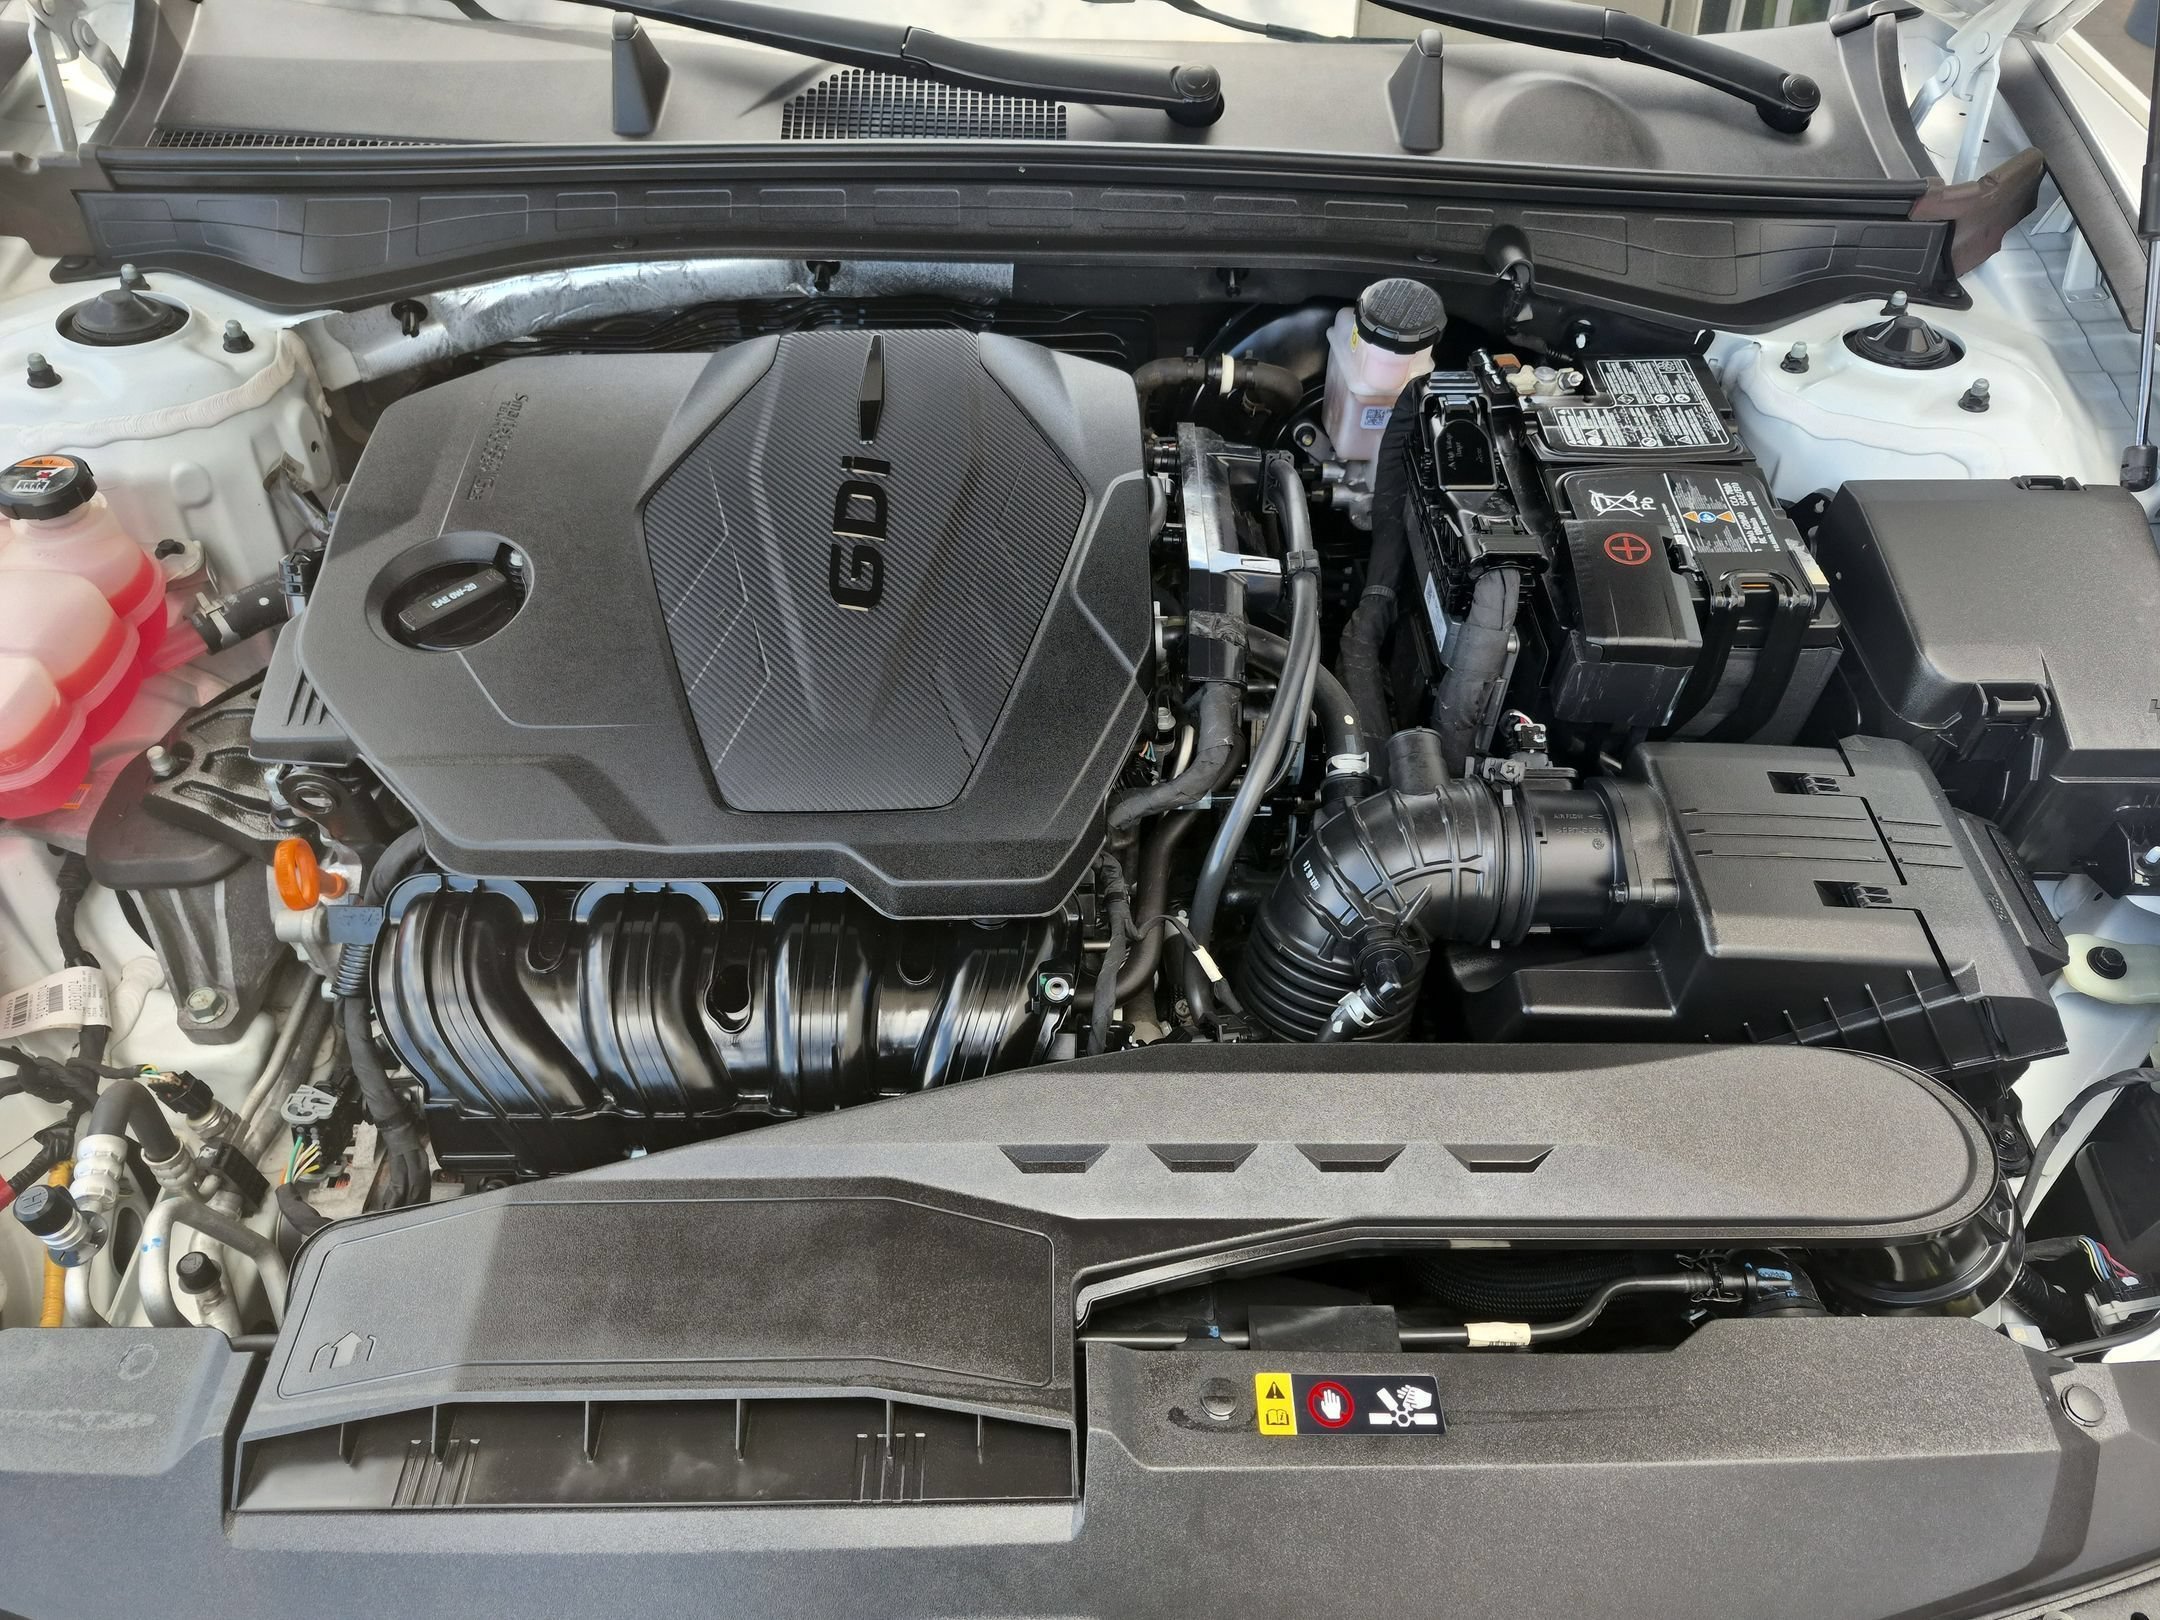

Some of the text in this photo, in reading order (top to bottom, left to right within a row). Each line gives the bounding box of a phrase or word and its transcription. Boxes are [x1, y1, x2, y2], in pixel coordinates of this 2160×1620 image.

[1640, 497, 1657, 510] Pb
[431, 582, 478, 609] SAE 0W-20
